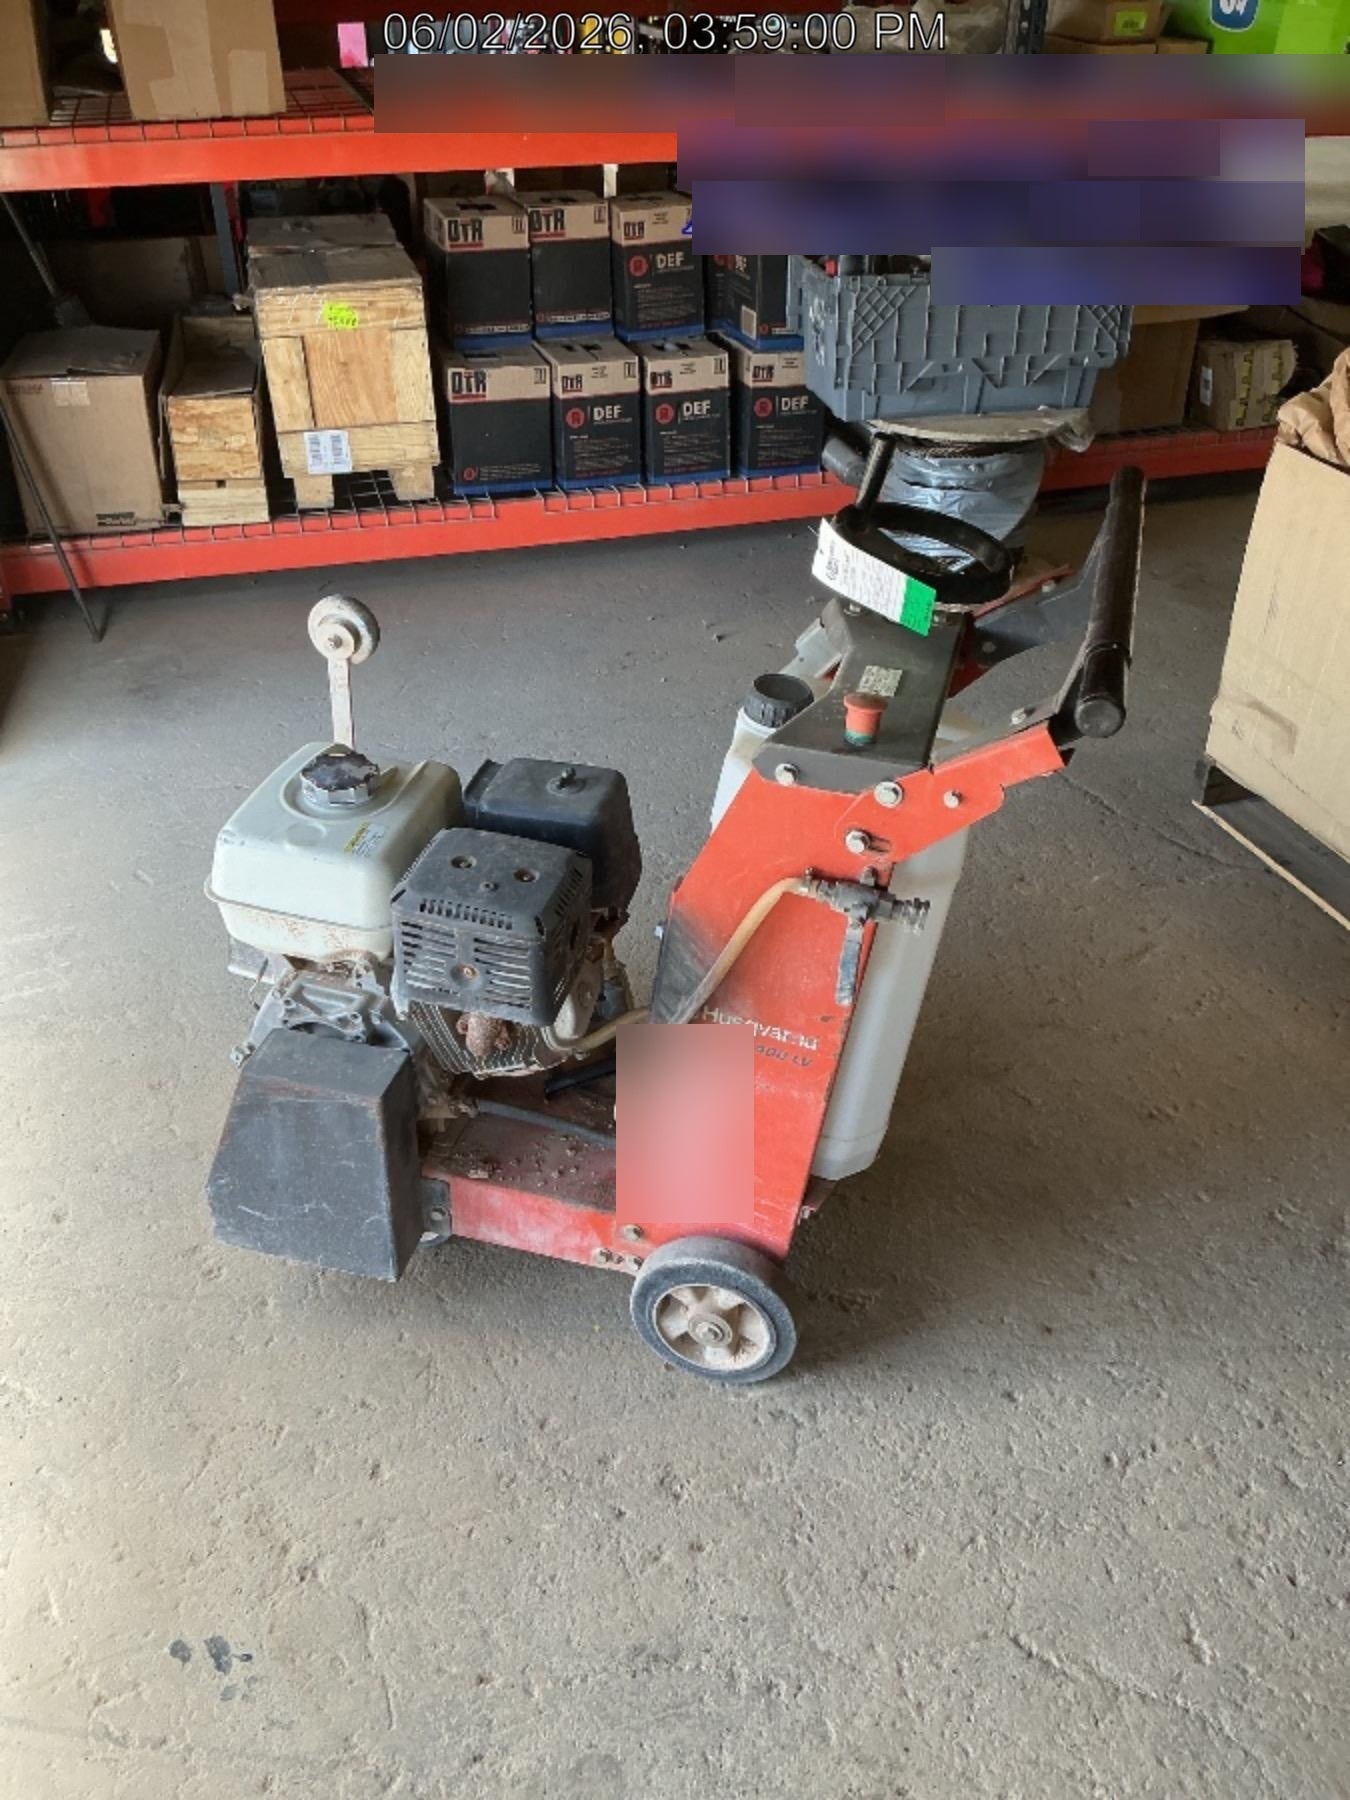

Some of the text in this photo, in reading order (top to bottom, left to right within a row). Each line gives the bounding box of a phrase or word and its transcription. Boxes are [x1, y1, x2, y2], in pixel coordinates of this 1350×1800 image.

[656, 251, 685, 269] DEF
[683, 400, 711, 417] DEF
[781, 396, 809, 411] DEF
[593, 405, 622, 421] DEF
